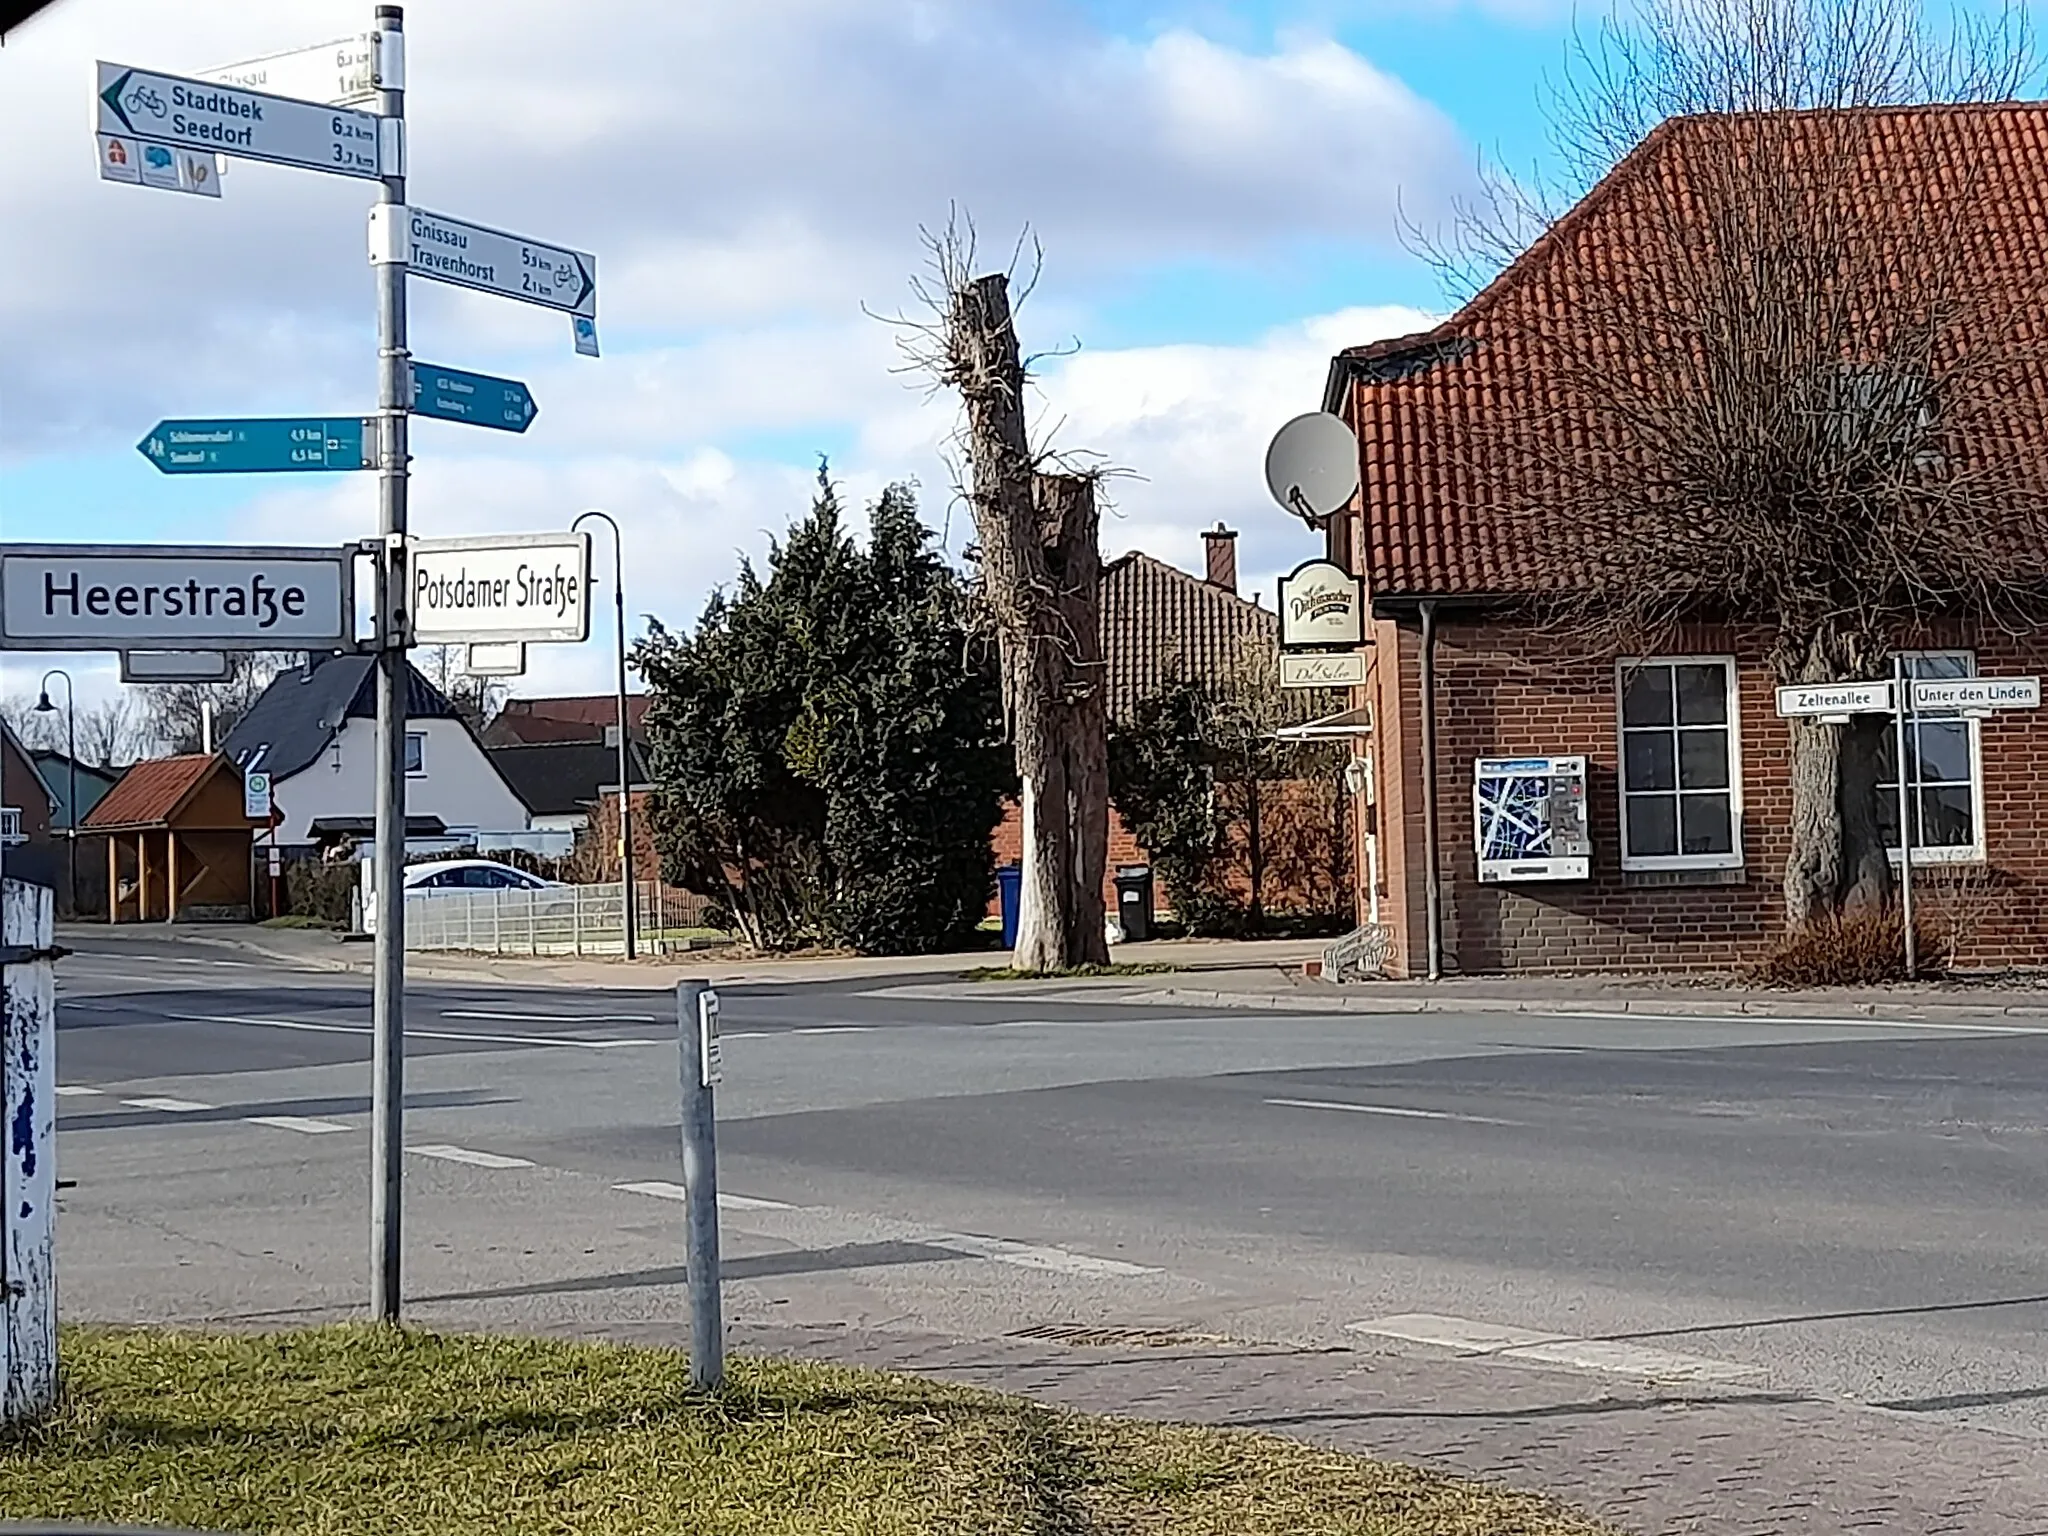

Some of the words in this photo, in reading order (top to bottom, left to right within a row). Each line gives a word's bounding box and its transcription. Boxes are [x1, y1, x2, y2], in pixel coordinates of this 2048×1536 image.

[171, 85, 265, 121] Stadtbek
[355, 126, 374, 141] km
[172, 114, 253, 146] Seedorf
[356, 153, 375, 168] km
[411, 217, 468, 249] Gnissau
[538, 257, 552, 271] km
[411, 243, 495, 282] Travenhorst
[538, 282, 552, 296] km
[44, 572, 306, 629] Heerstraße
[416, 567, 511, 609] Potsdamer
[516, 563, 578, 618] Straße
[1797, 692, 1871, 707] Zeltenallee
[1917, 688, 1955, 702] Unter
[1959, 688, 1984, 700] den
[1988, 686, 2032, 700] Linden
